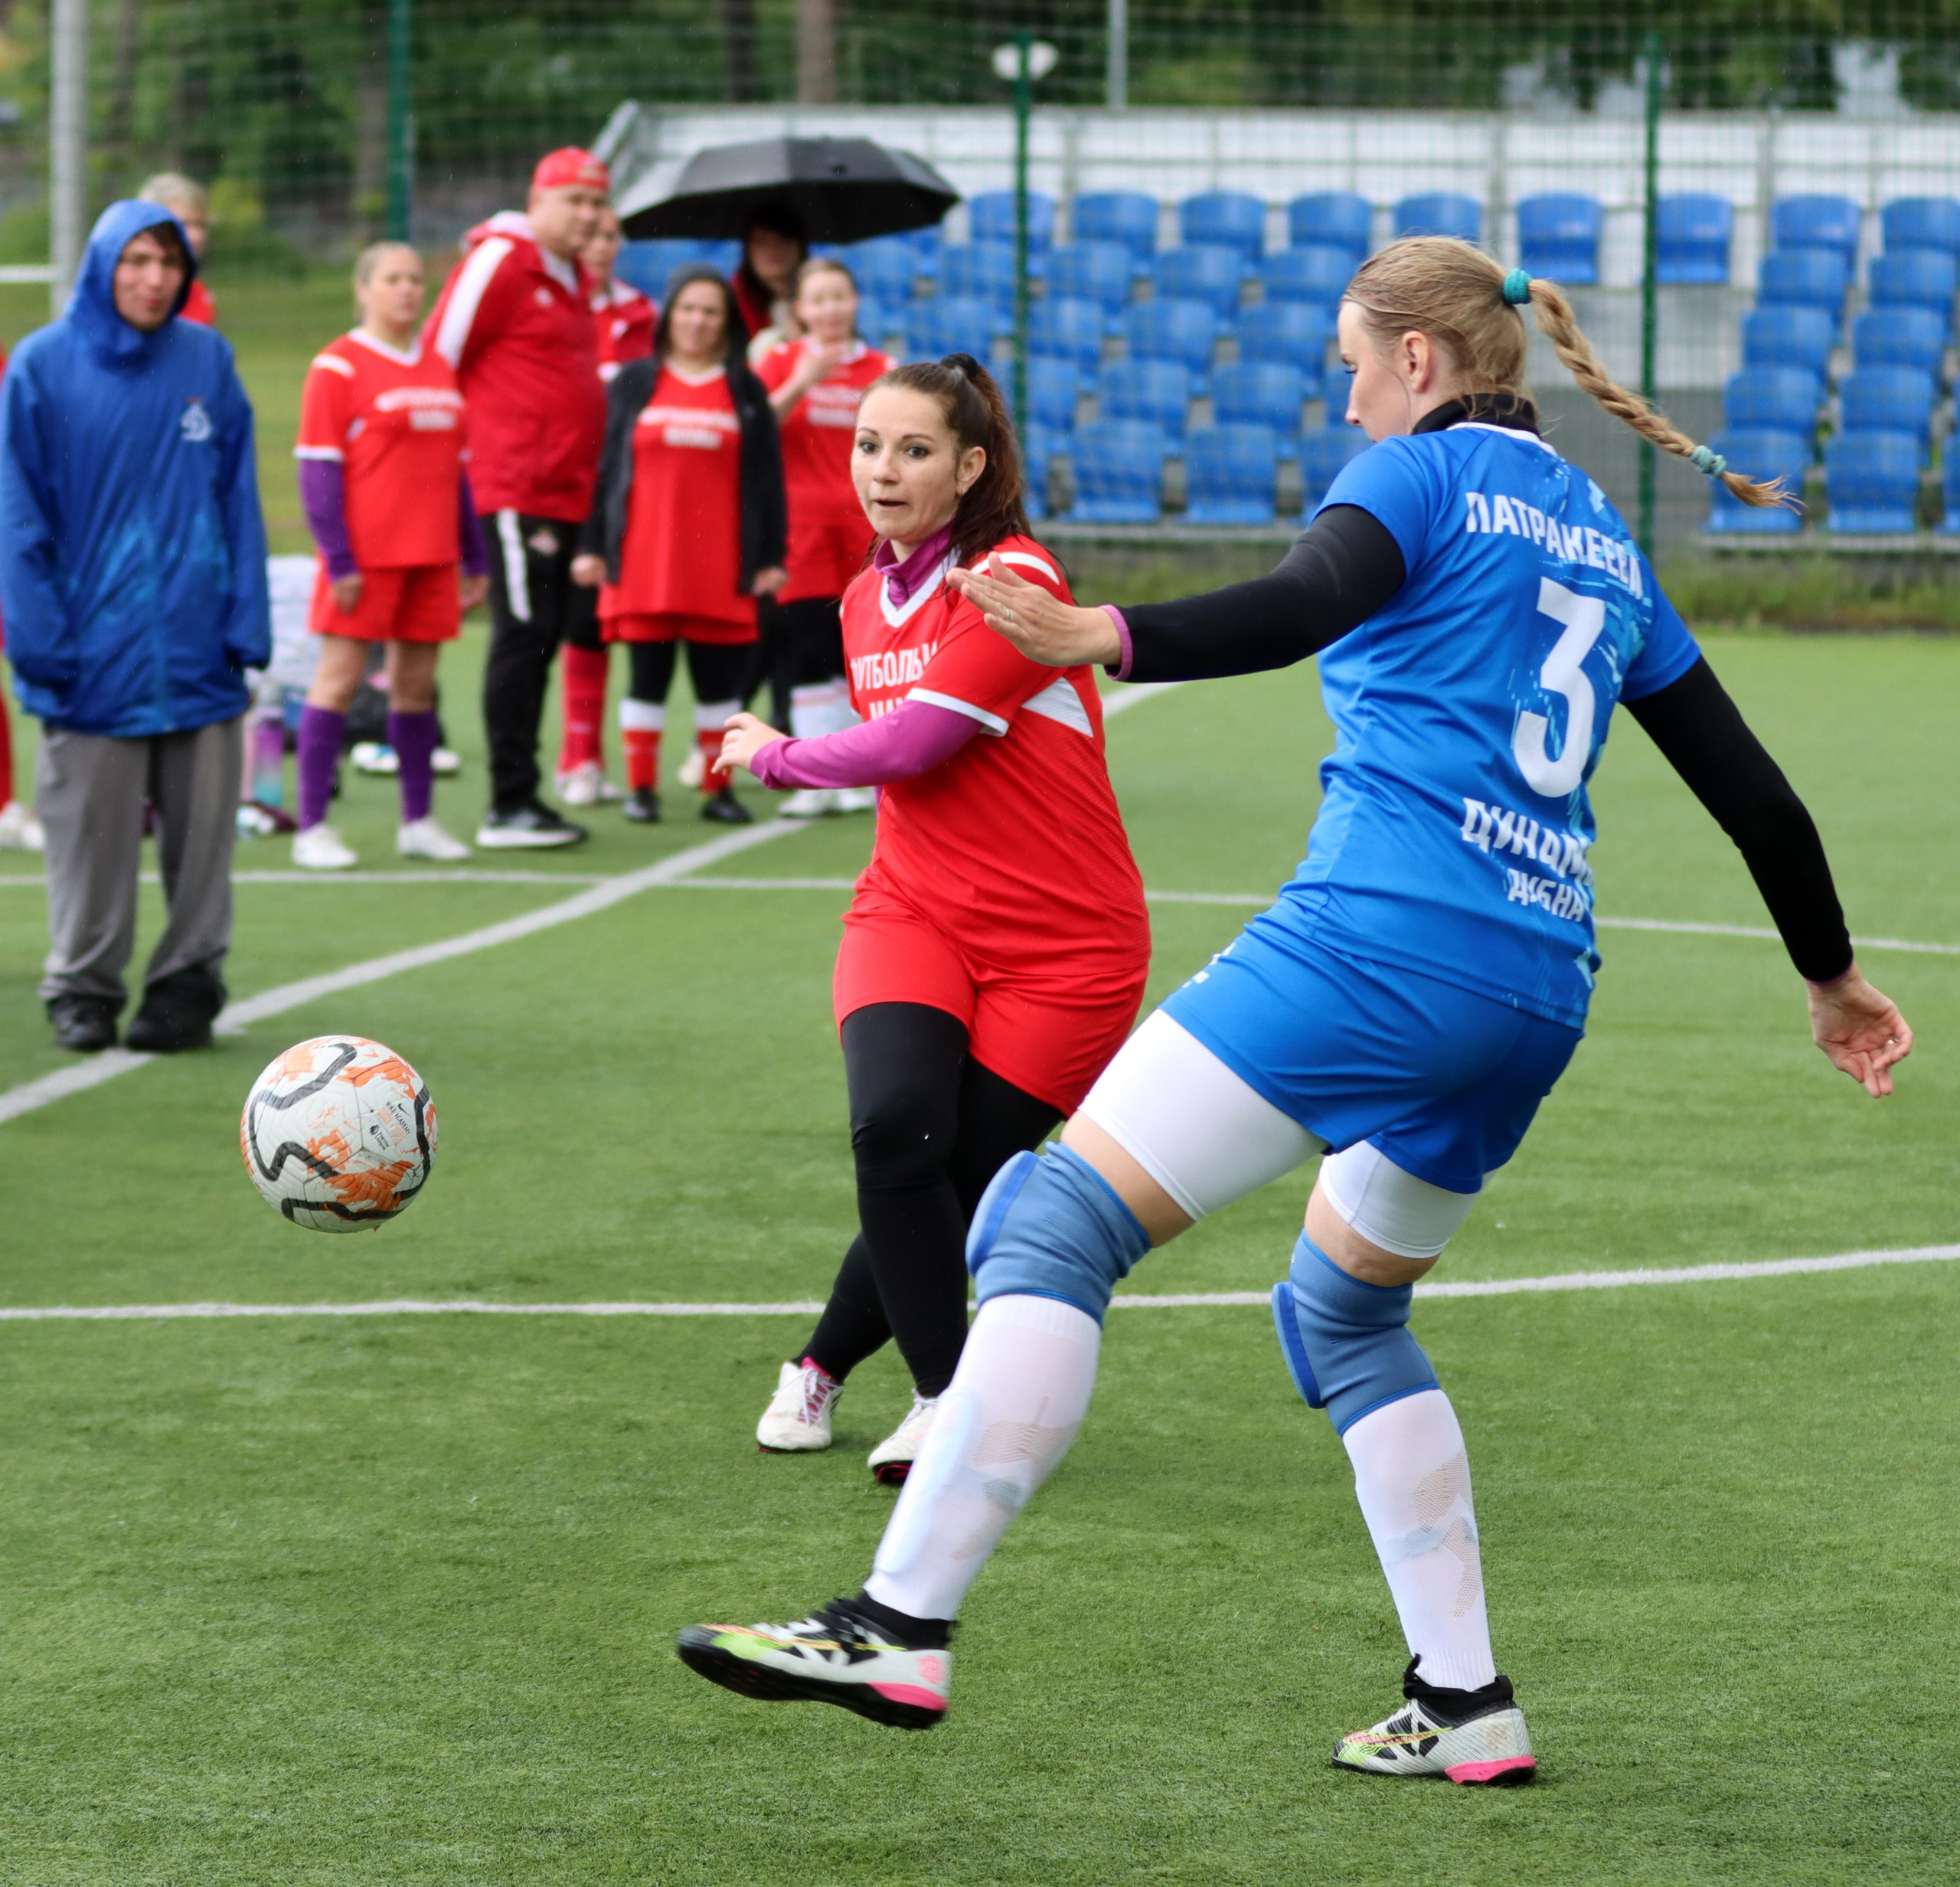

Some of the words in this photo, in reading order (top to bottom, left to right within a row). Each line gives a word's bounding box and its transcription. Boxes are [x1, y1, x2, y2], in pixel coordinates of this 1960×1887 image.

[851, 640, 937, 691] УТБОЛЬ
[1513, 576, 1606, 798] 3
[1460, 797, 1594, 887] ДИНАМ
[385, 1101, 397, 1114] NIKE
[394, 1113, 410, 1135] ACADEMY
